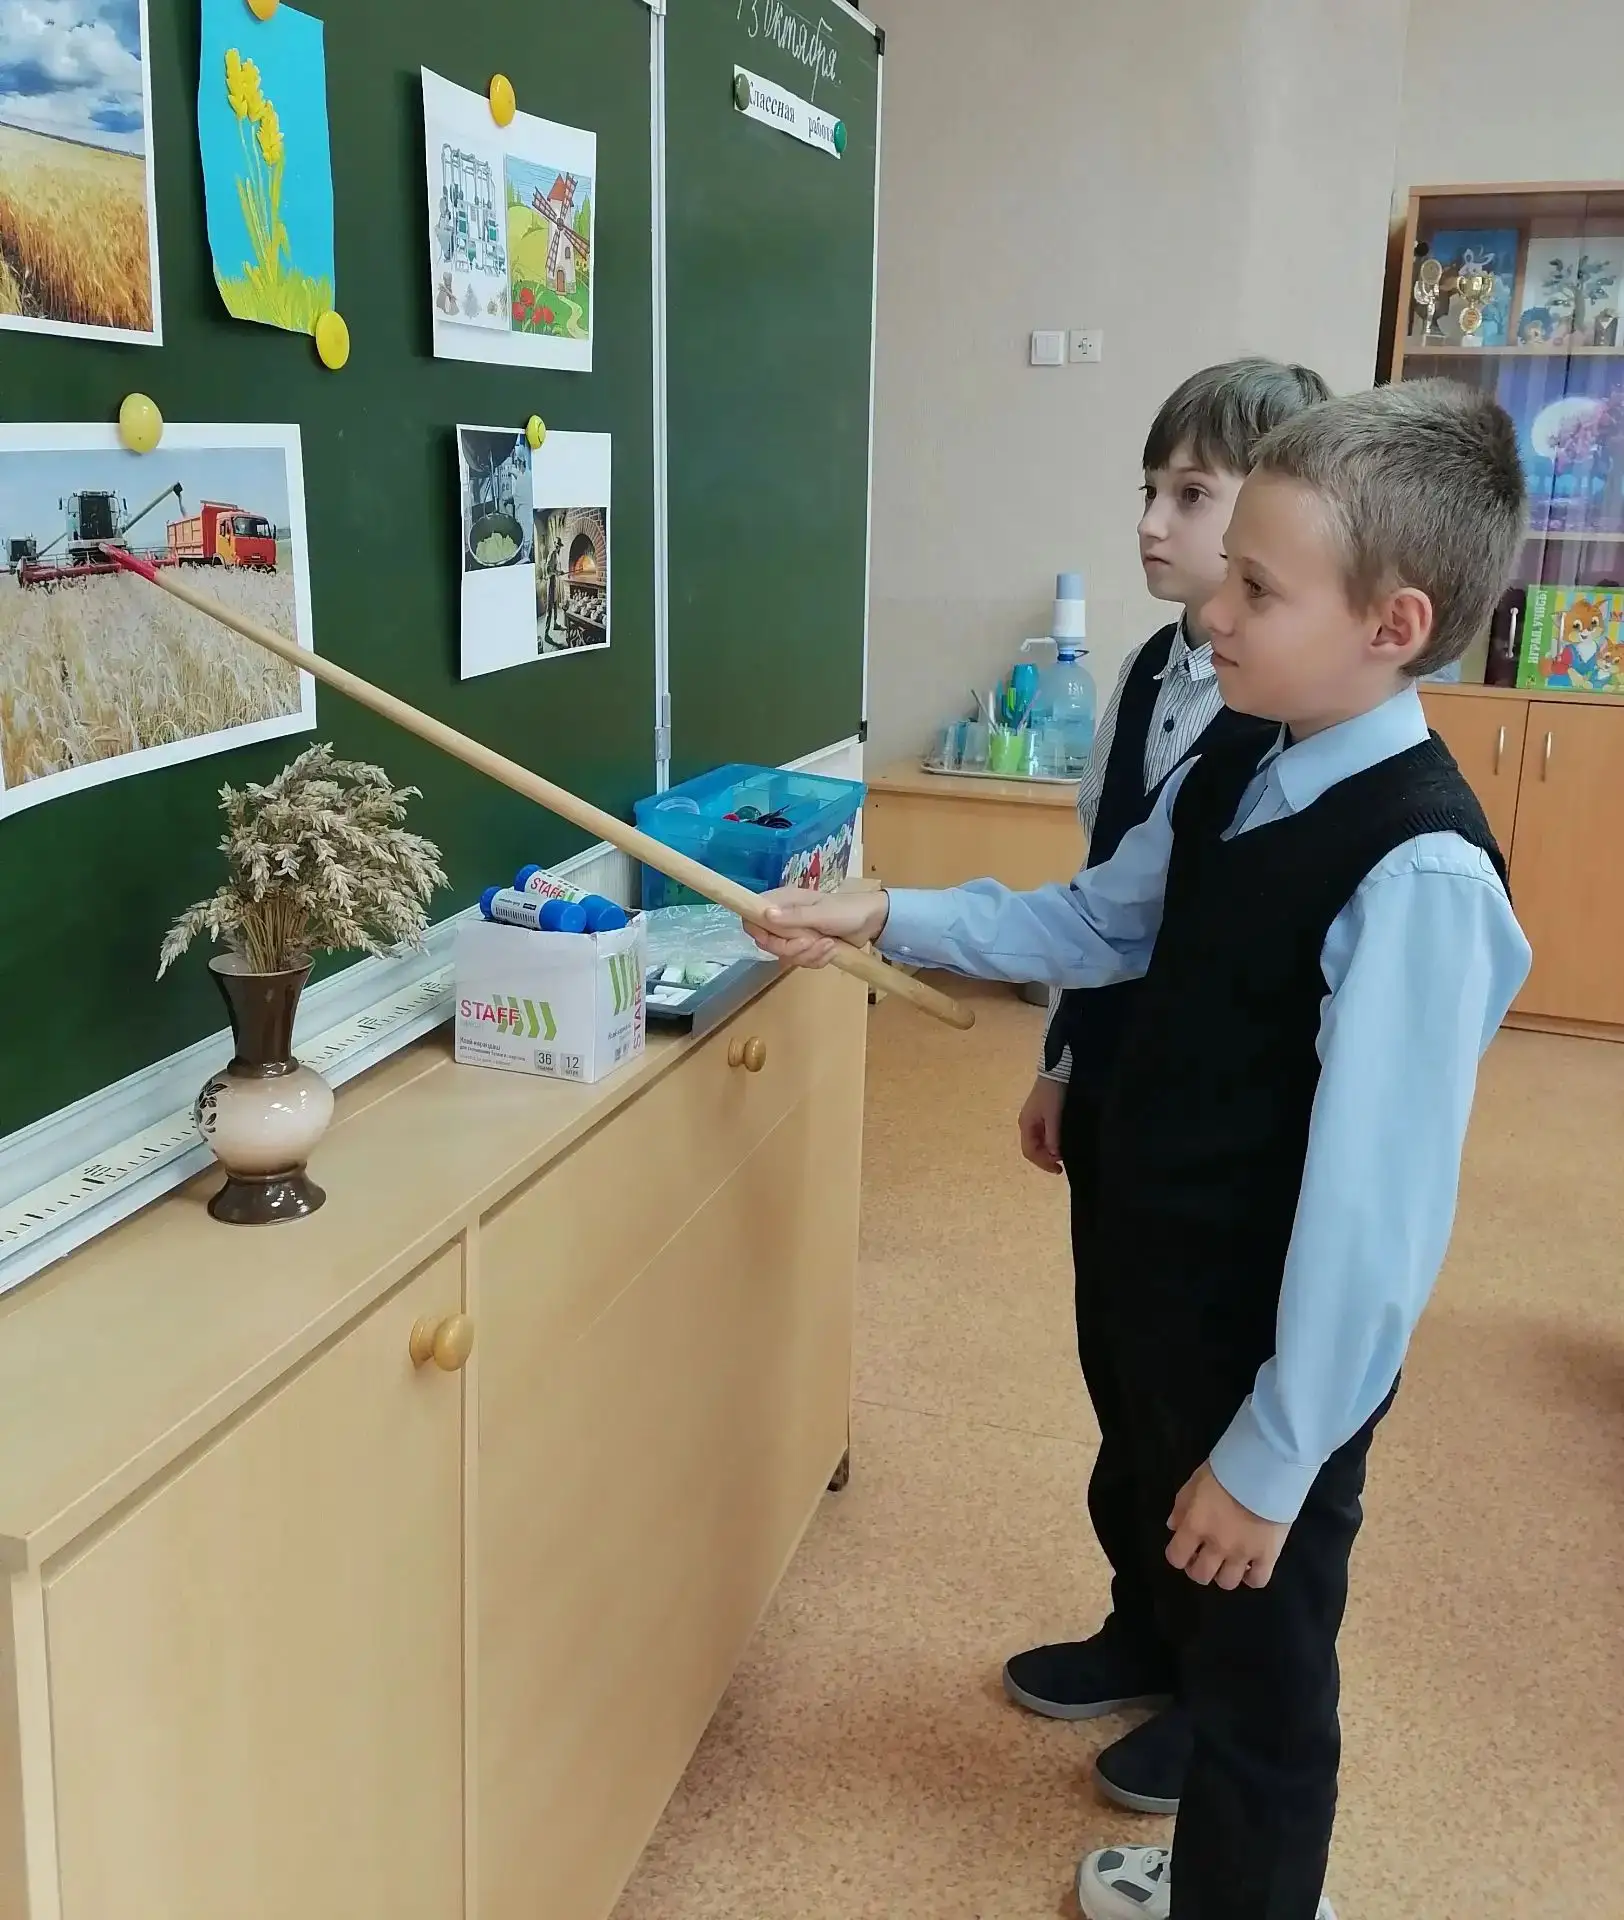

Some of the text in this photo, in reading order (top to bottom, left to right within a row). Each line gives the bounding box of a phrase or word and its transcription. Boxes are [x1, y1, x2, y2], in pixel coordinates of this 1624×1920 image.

[530, 876, 566, 901] STAFF
[460, 998, 521, 1027] STAFF
[633, 982, 642, 1050] STAFF
[538, 1052, 552, 1066] 36
[565, 1056, 580, 1069] 12
